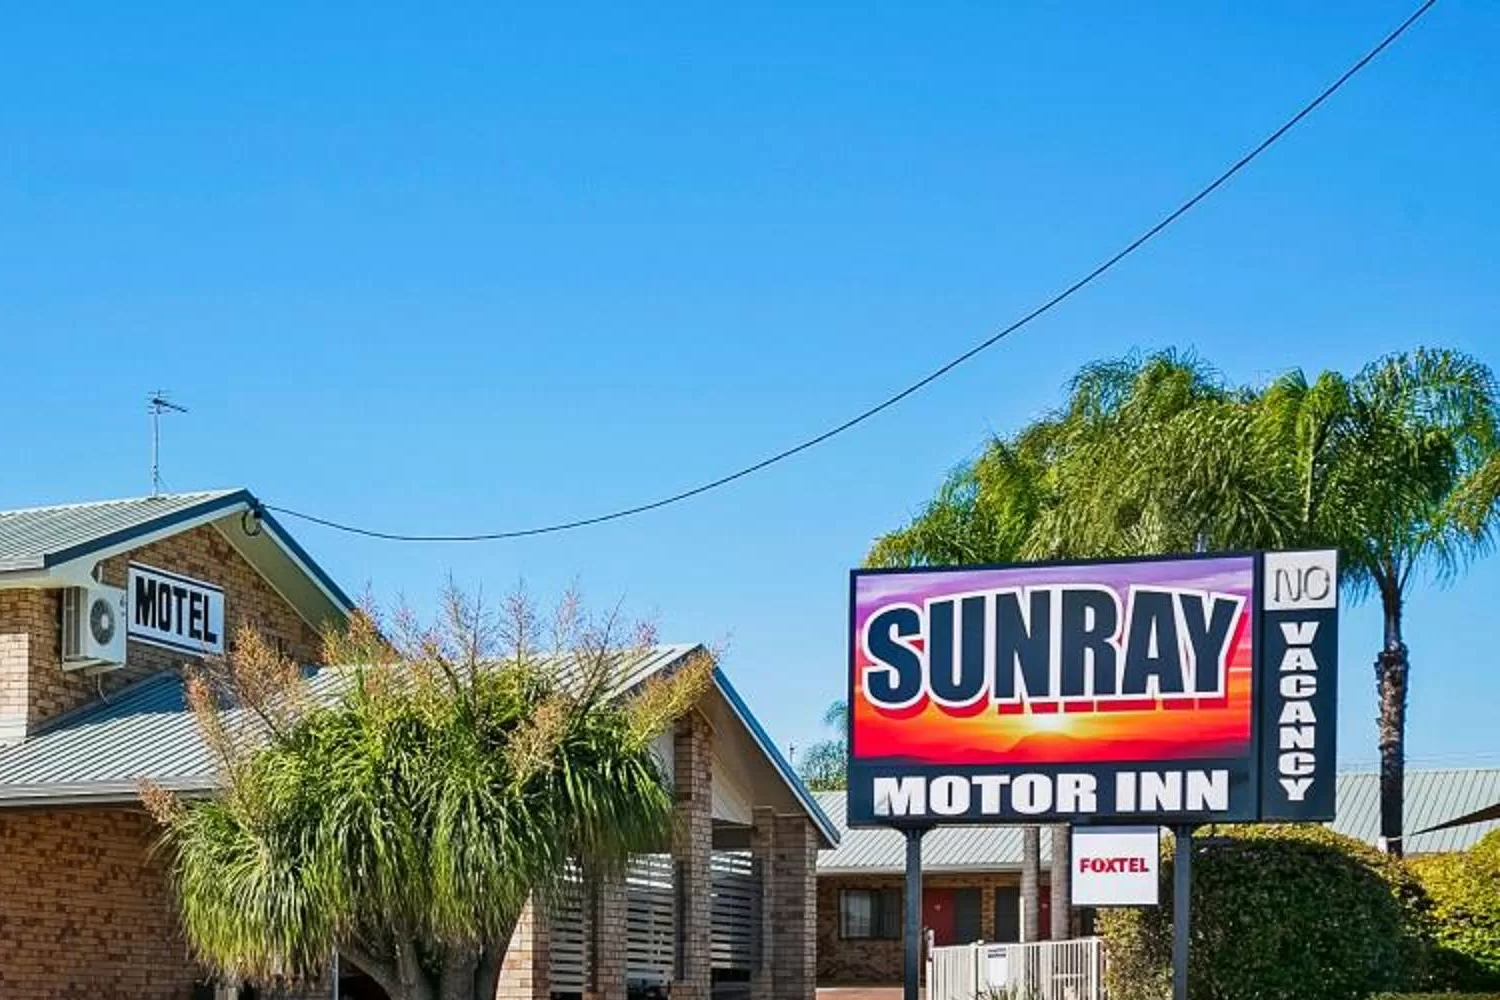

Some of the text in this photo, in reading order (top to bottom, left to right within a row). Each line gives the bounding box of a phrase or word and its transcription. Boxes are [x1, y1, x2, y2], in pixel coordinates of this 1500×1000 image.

[135, 575, 217, 644] MOTEL
[1274, 565, 1331, 602] NO
[863, 584, 1246, 708] SUNRAY
[1278, 621, 1320, 801] VACANCY
[873, 769, 1229, 816] MOTOR INN
[1079, 857, 1149, 874] FOXTEL
